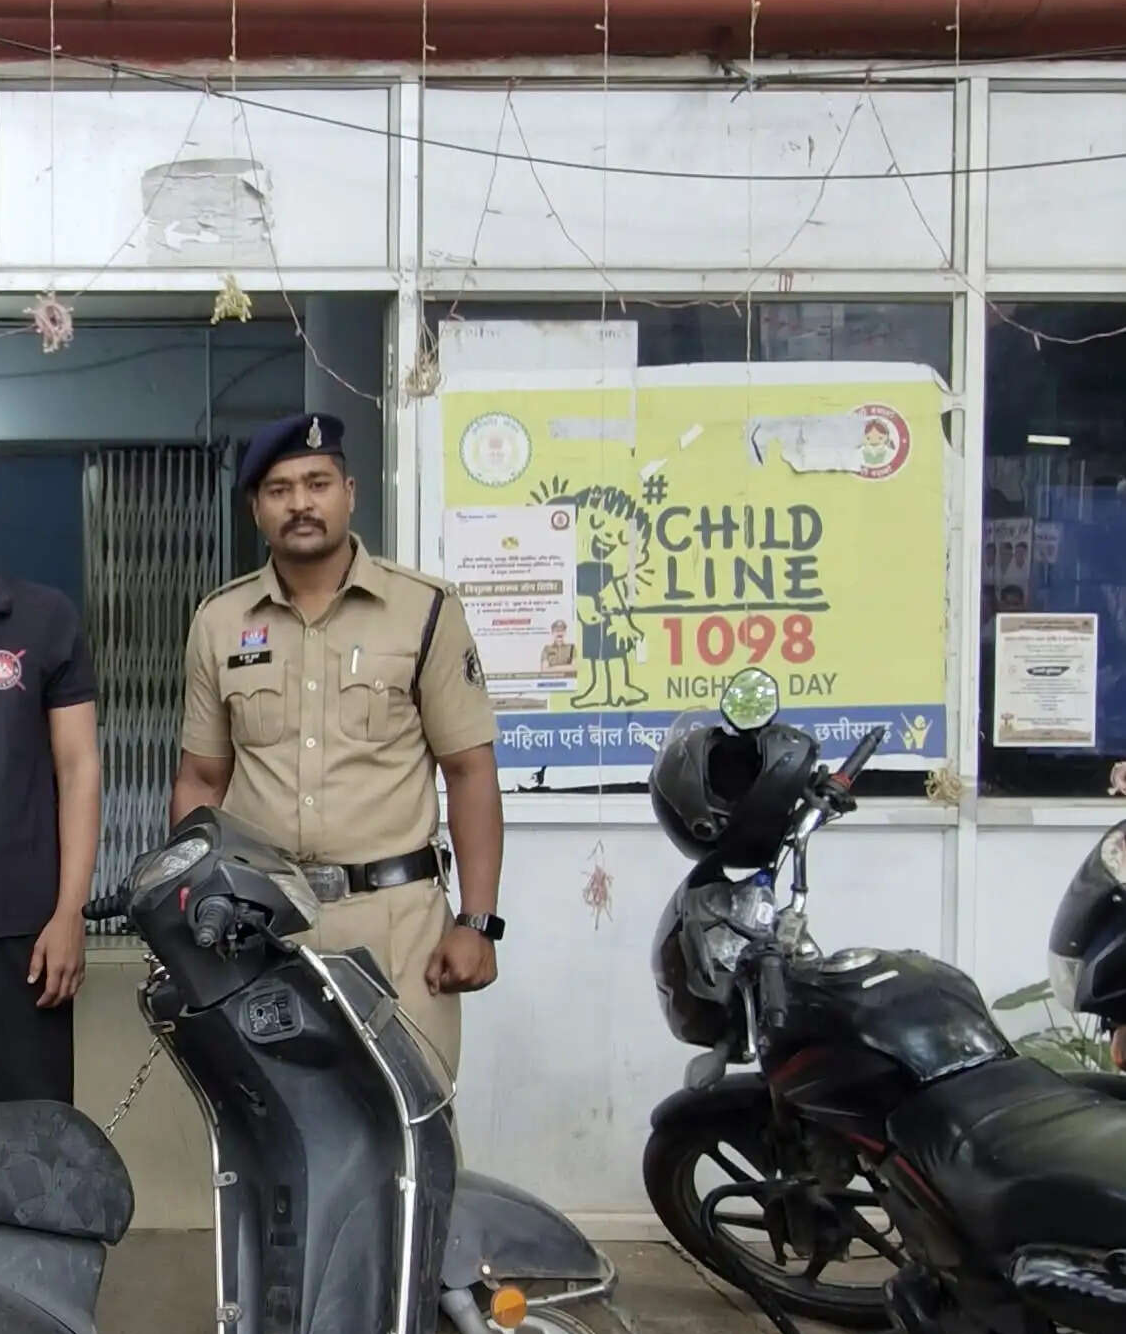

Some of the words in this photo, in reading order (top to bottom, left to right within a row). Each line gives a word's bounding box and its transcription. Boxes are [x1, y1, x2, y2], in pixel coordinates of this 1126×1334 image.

[656, 504, 823, 552] CHILD
[664, 555, 824, 600] LINE
[663, 614, 816, 665] 1098
[667, 675, 735, 699] NIGH
[789, 672, 837, 696] DAY
[502, 724, 555, 750] महिला
[558, 725, 584, 749] एवं
